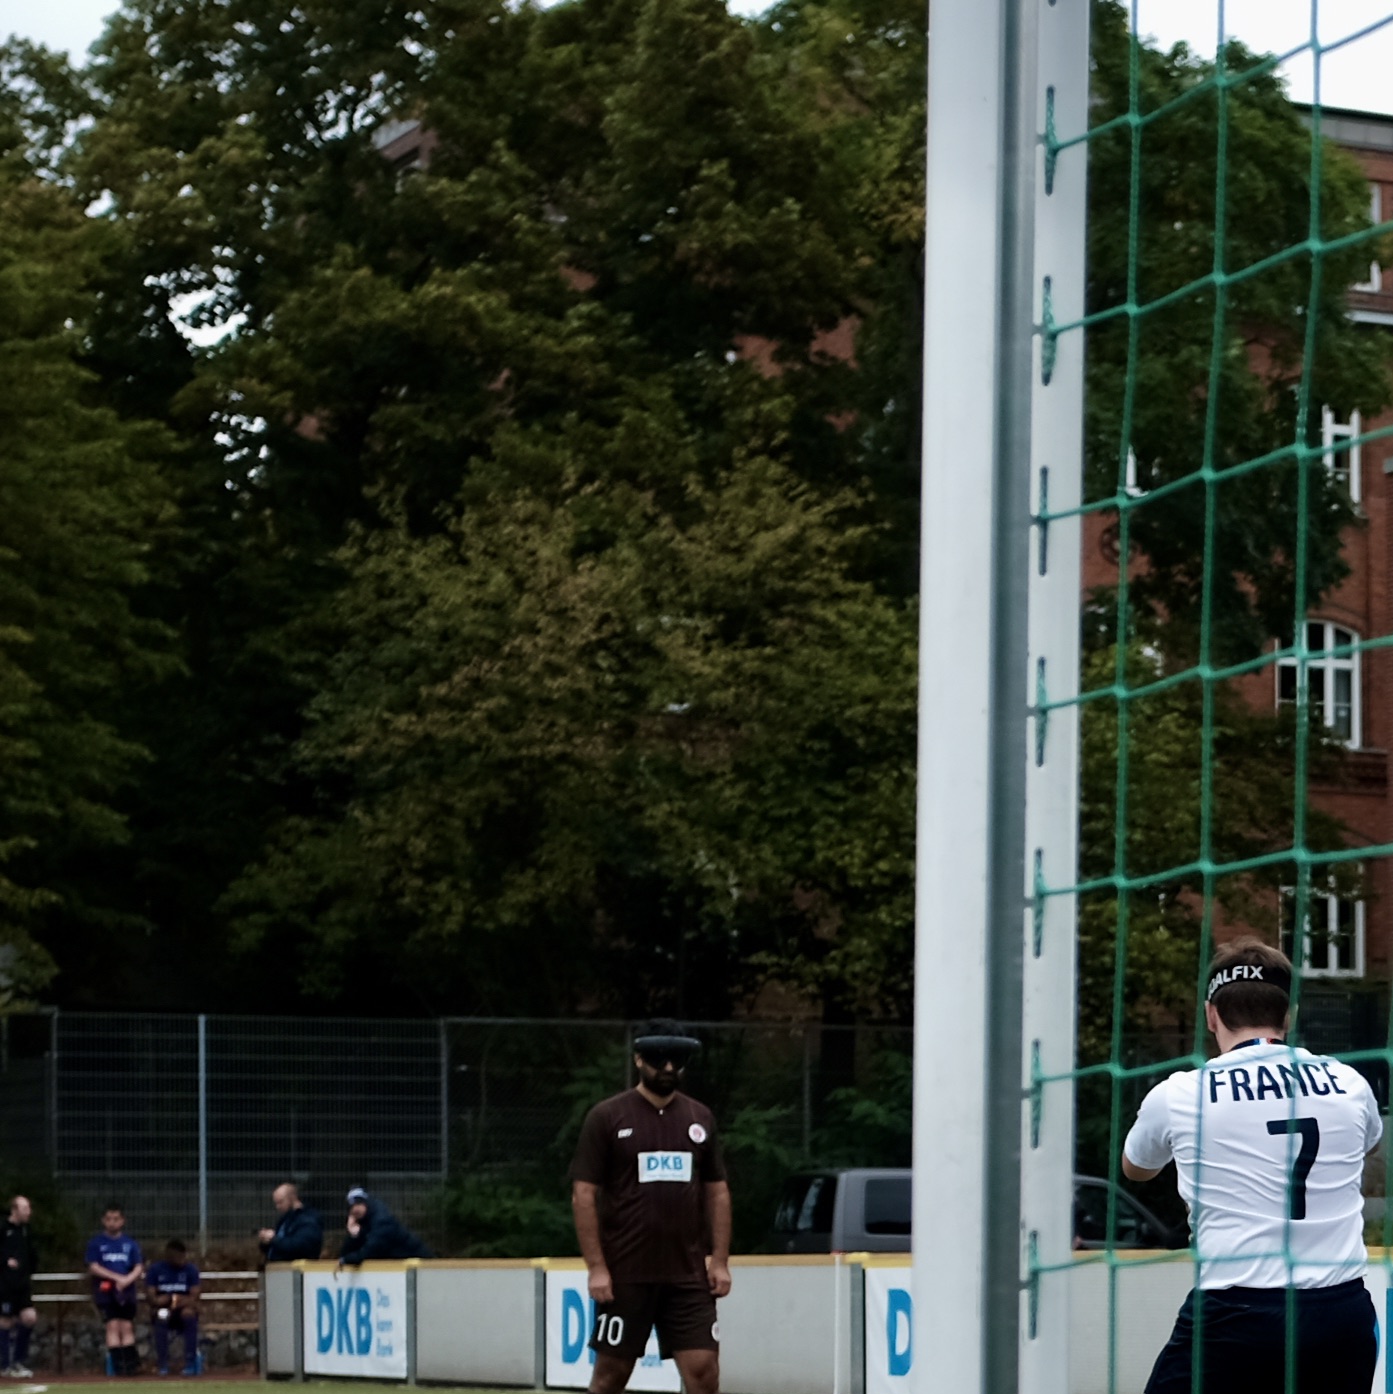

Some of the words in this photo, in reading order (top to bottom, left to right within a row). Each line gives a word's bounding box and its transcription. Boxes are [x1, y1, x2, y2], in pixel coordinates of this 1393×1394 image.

[1209, 1061, 1347, 1103] FRANCE
[646, 1155, 683, 1171] DKB
[1266, 1117, 1320, 1220] 7
[316, 1287, 372, 1356] DKB
[597, 1313, 624, 1346] 10
